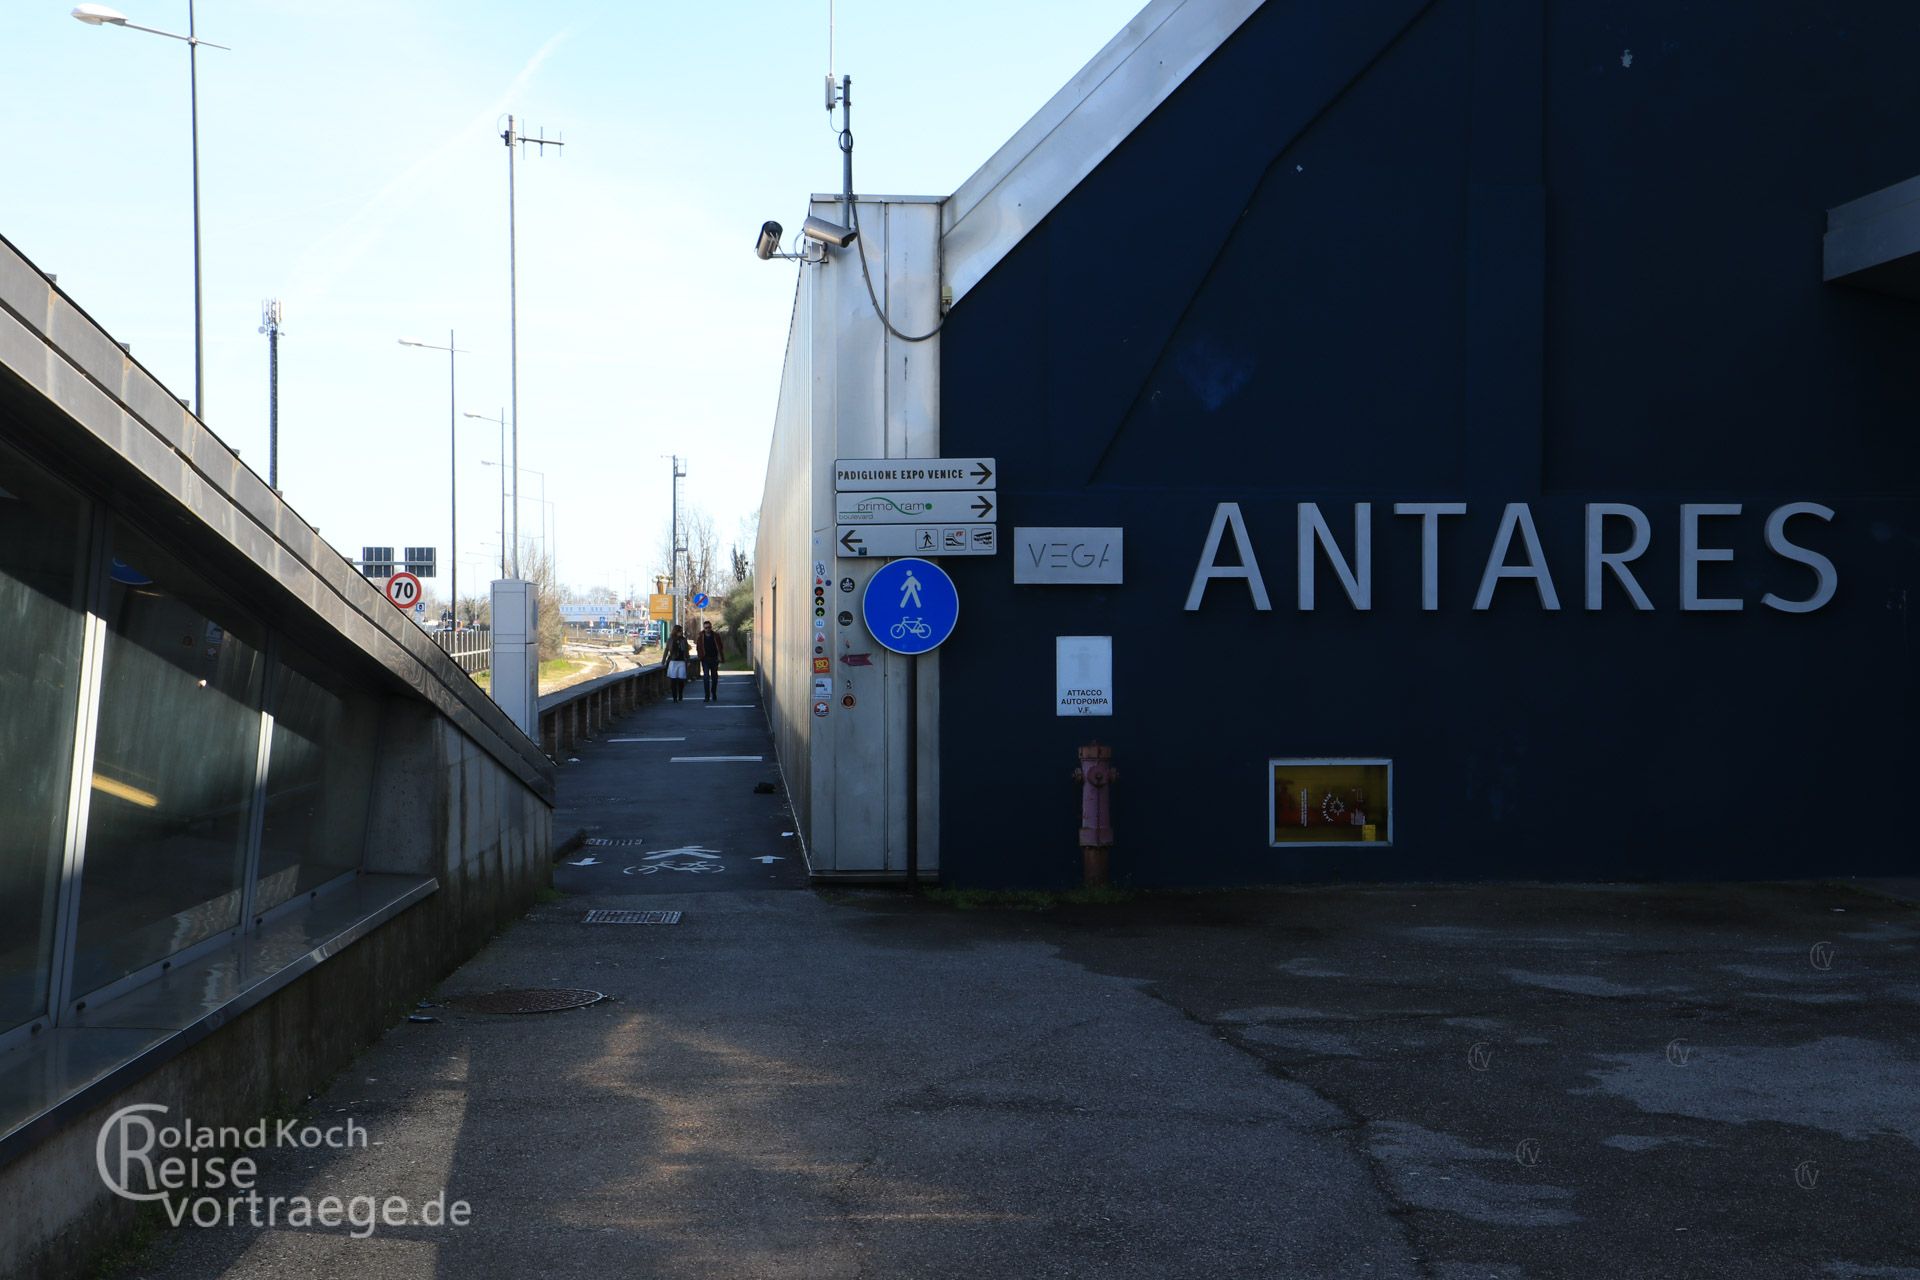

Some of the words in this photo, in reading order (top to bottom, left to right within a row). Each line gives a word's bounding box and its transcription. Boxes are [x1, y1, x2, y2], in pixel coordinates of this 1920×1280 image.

[837, 470, 897, 481] PADIGLIONE
[901, 469, 924, 480] EXPO
[928, 469, 964, 479] VENICE
[838, 513, 874, 521] boulevard
[1028, 543, 1110, 569] VEGA
[1183, 501, 1839, 613] ANTARES
[394, 582, 414, 599] 70
[1067, 689, 1102, 697] ATTACCO
